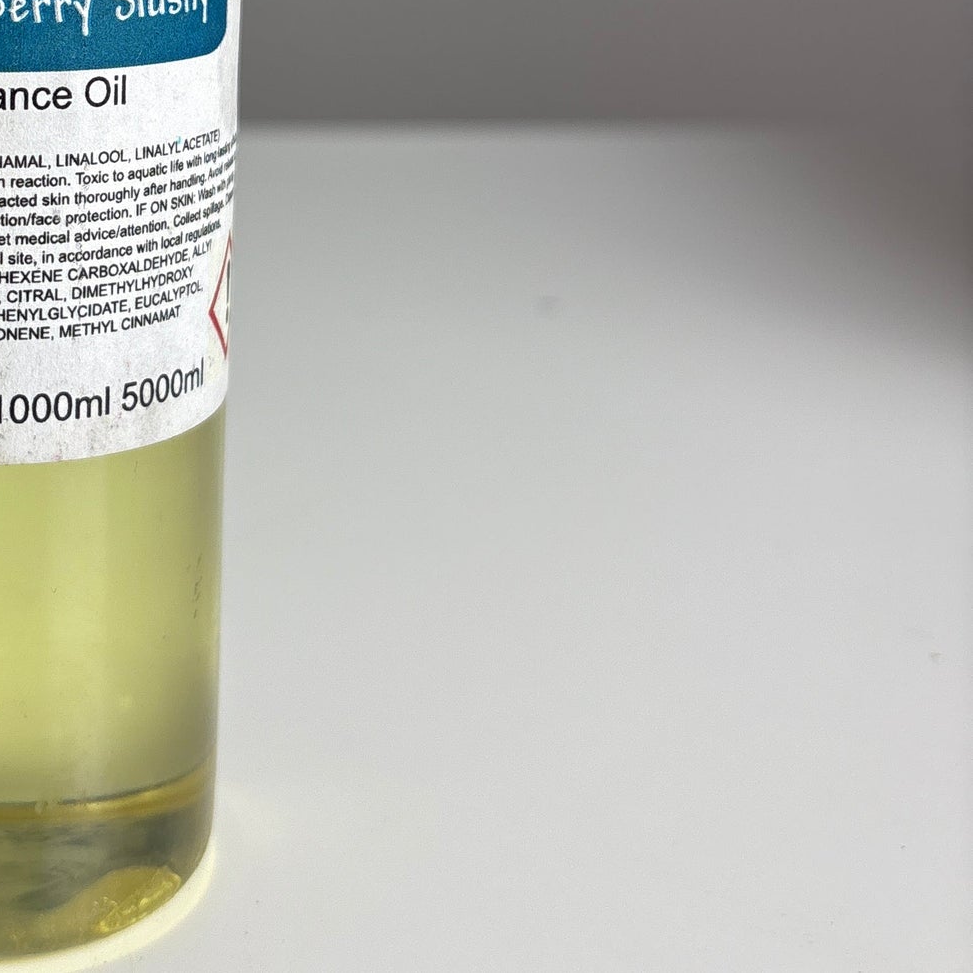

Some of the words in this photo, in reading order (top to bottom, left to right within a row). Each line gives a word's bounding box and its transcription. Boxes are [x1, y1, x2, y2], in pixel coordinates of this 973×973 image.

[85, 75, 127, 106] Oil
[56, 150, 131, 168] LINALOOL,
[135, 141, 181, 160] LINALYL
[183, 129, 220, 151] ACETATE)
[11, 171, 71, 187] reaction.
[76, 171, 109, 185] Toxic
[113, 170, 124, 181] to
[127, 163, 167, 181] aquatic
[170, 157, 184, 173] life
[187, 152, 201, 168] with
[42, 191, 69, 206] skin
[75, 188, 140, 205] thoroughly
[143, 180, 166, 195] after
[170, 173, 206, 192] handling.
[66, 208, 132, 226] protection.
[136, 203, 147, 216] IF
[151, 199, 167, 213] ON
[171, 194, 196, 209] SKIN:
[198, 187, 215, 201] Wash
[217, 179, 226, 192] with
[8, 251, 37, 265] site,
[42, 249, 54, 263] in
[58, 243, 132, 263] accordance
[137, 237, 157, 254] with
[161, 230, 182, 249] local
[185, 220, 221, 244] regulations.
[16, 228, 69, 244] medical
[74, 220, 169, 242] advice/attention.
[173, 209, 201, 227] Collect
[68, 249, 190, 282] CARBOXALDEHYDE,
[7, 287, 67, 303] CITRAL,
[72, 265, 194, 300] DIMETHYLHYDROXY
[59, 320, 118, 338] METHYL
[121, 357, 204, 412] 5000ml
